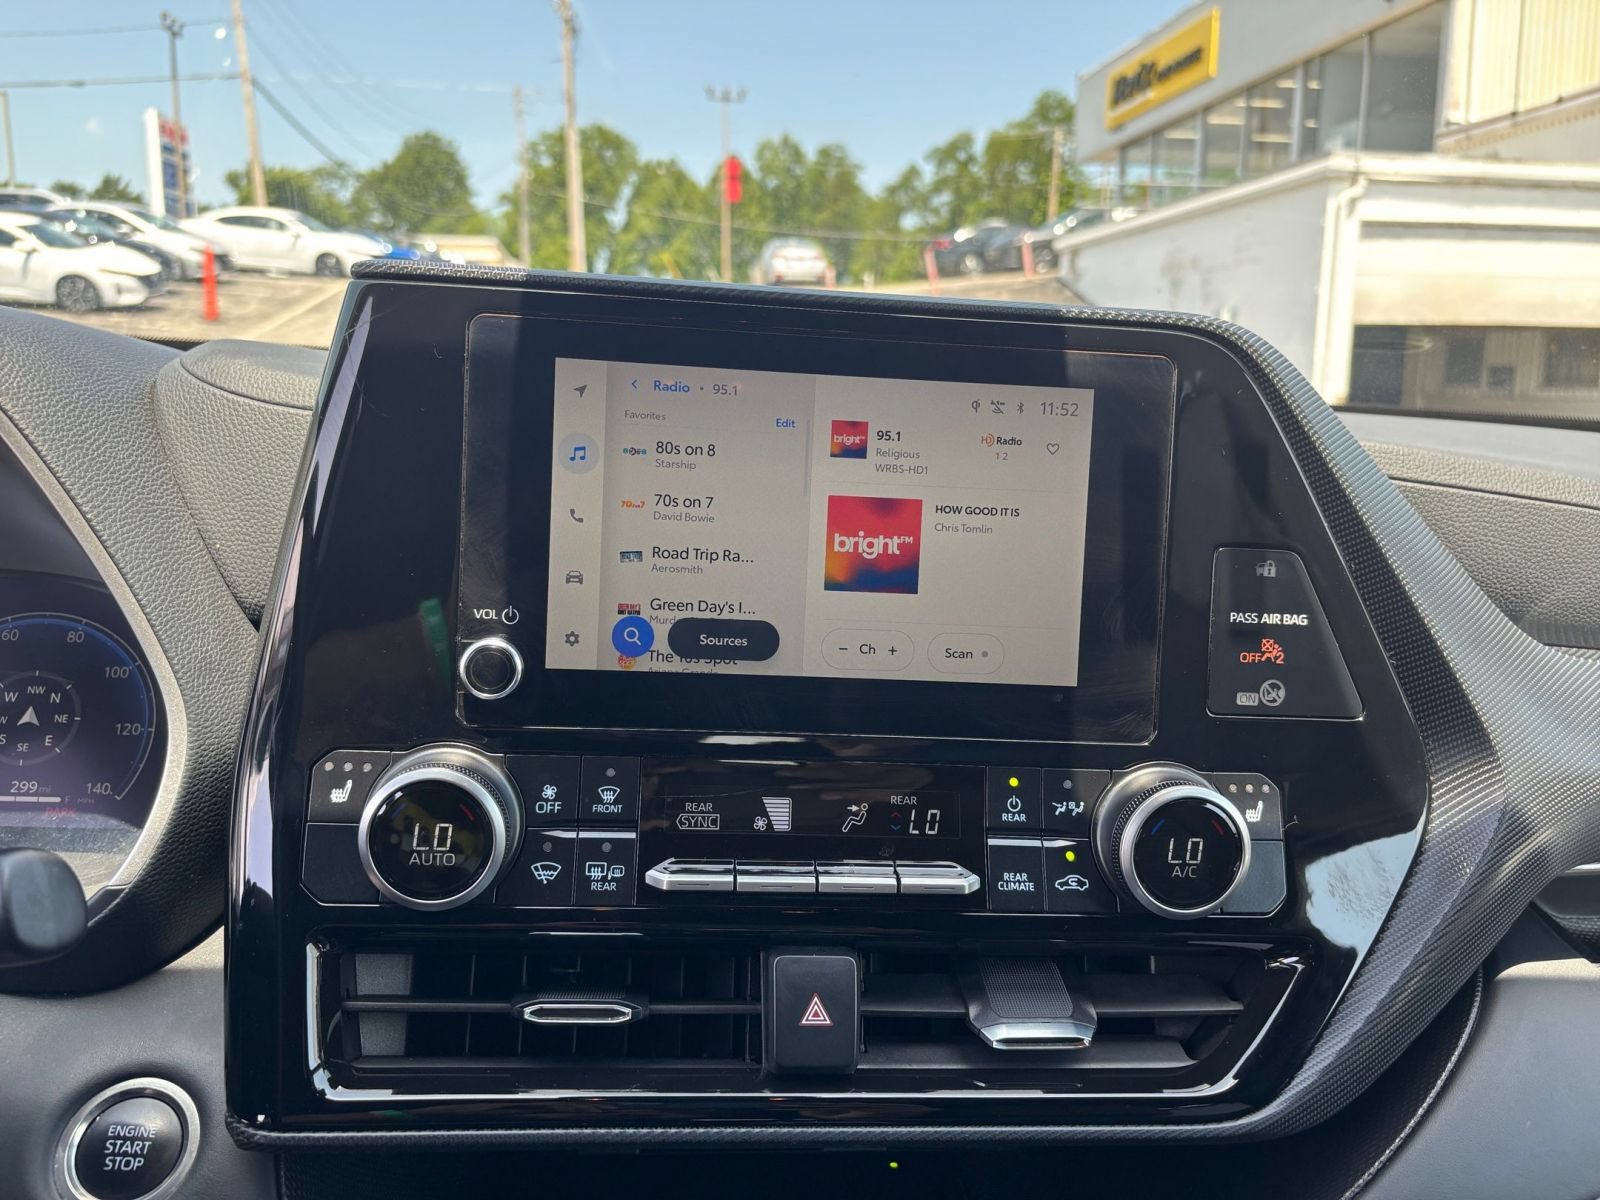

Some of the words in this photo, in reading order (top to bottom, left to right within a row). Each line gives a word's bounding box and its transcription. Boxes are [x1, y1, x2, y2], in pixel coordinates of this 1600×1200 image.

[653, 380, 690, 394] Radio
[713, 384, 738, 396] 95.1
[624, 410, 667, 421] Favorites
[1040, 402, 1079, 417] 11:52
[775, 418, 796, 429] Edit
[877, 430, 901, 442] 95.1
[996, 436, 1022, 446] Radio
[656, 441, 681, 455] 80s
[685, 445, 703, 456] on
[707, 444, 716, 457] 8
[876, 448, 920, 460] Religious
[655, 459, 697, 471] Starship
[875, 464, 928, 475] WRBS-HD1
[654, 494, 679, 507] 70s
[683, 498, 701, 508] on
[705, 497, 714, 509] 7
[653, 511, 682, 522] David
[685, 512, 715, 523] Bowie
[936, 505, 962, 515] HOW
[965, 506, 998, 517] GOOD
[1000, 507, 1010, 517] IT
[1011, 508, 1020, 517] IS
[934, 522, 959, 533] Chris
[962, 523, 993, 534] Tomlin
[652, 546, 689, 560] Road
[693, 548, 719, 564] Trip
[651, 564, 703, 575] Aerosmith
[650, 598, 693, 612] Green
[698, 600, 736, 616] Day's
[474, 609, 498, 619] VOL
[1230, 612, 1258, 624] PASS
[1261, 613, 1281, 624] AIR
[1283, 614, 1309, 626] BAG
[1, 629, 19, 641] 60
[66, 631, 85, 643] 80
[699, 634, 748, 647] Sources
[859, 643, 876, 655] Ch
[945, 648, 973, 660] Scan
[648, 649, 674, 662] The
[1240, 652, 1262, 663] OFF
[104, 666, 129, 678] 100
[27, 685, 46, 695] NW
[4, 691, 19, 703] W
[50, 692, 61, 703] N
[1239, 694, 1256, 704] ON
[54, 714, 69, 723] NE
[115, 723, 141, 736] 120
[45, 735, 53, 746] E
[17, 743, 29, 752] SE
[10, 780, 38, 793] 299
[87, 782, 111, 794] 140
[890, 795, 917, 805] REAR
[535, 801, 562, 814] OFF
[592, 804, 623, 814] FRONT
[685, 802, 713, 812] REAR
[681, 815, 718, 828] SYNC
[1002, 813, 1026, 822] REAR
[409, 853, 456, 866] AUTO
[1003, 872, 1028, 882] REAR
[1172, 865, 1197, 878] A/C
[591, 881, 617, 891] REAR
[998, 881, 1035, 891] CLIMATE
[108, 1125, 158, 1138] ENGINE
[104, 1140, 152, 1154] START
[104, 1156, 144, 1171] STOP
